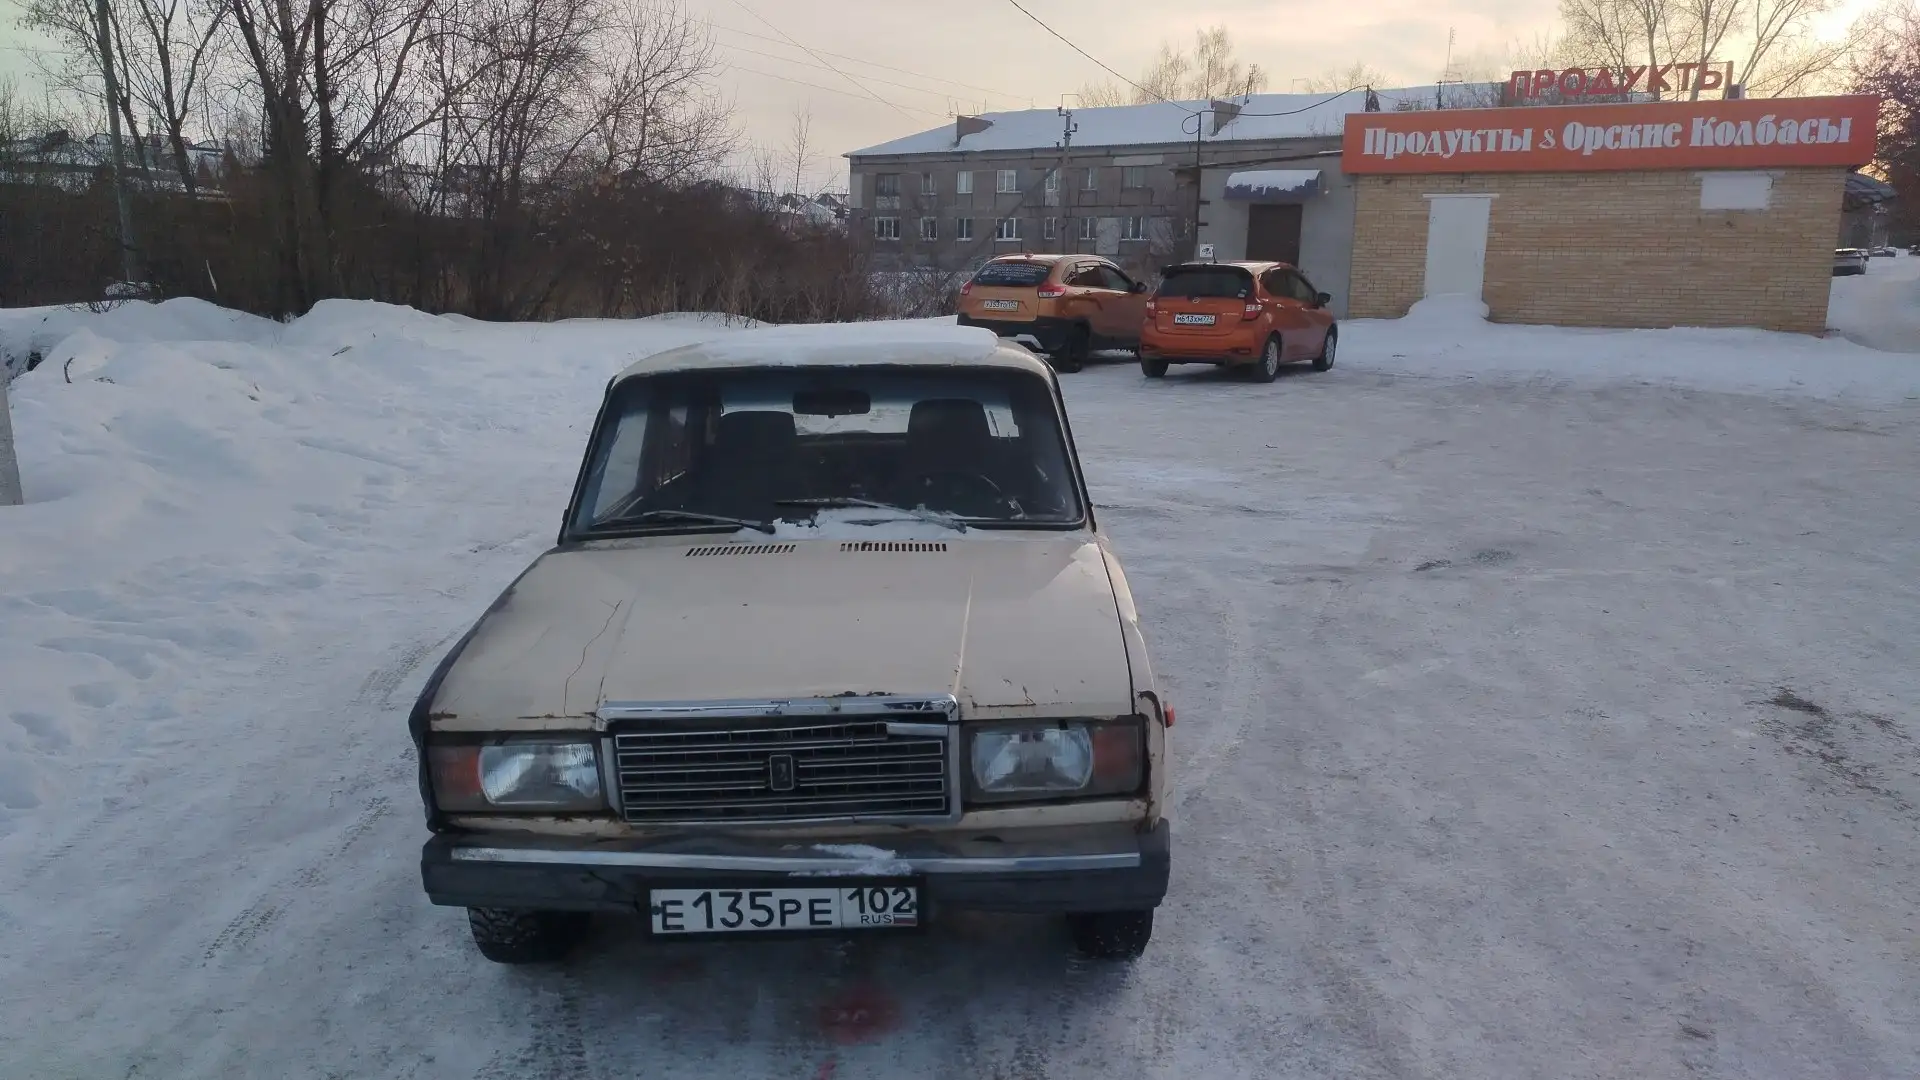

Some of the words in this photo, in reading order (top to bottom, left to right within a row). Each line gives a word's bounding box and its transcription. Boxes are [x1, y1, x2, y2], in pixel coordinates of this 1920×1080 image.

[1508, 61, 1734, 101] ПРОДУКТЫ
[1363, 127, 1533, 160] Продукты
[1539, 128, 1555, 149] &
[1562, 121, 1683, 156] Орские
[1689, 114, 1853, 147] Колбасы
[661, 891, 833, 931] Е135РЕ
[847, 887, 912, 914] 102
[860, 914, 892, 925] RUS
